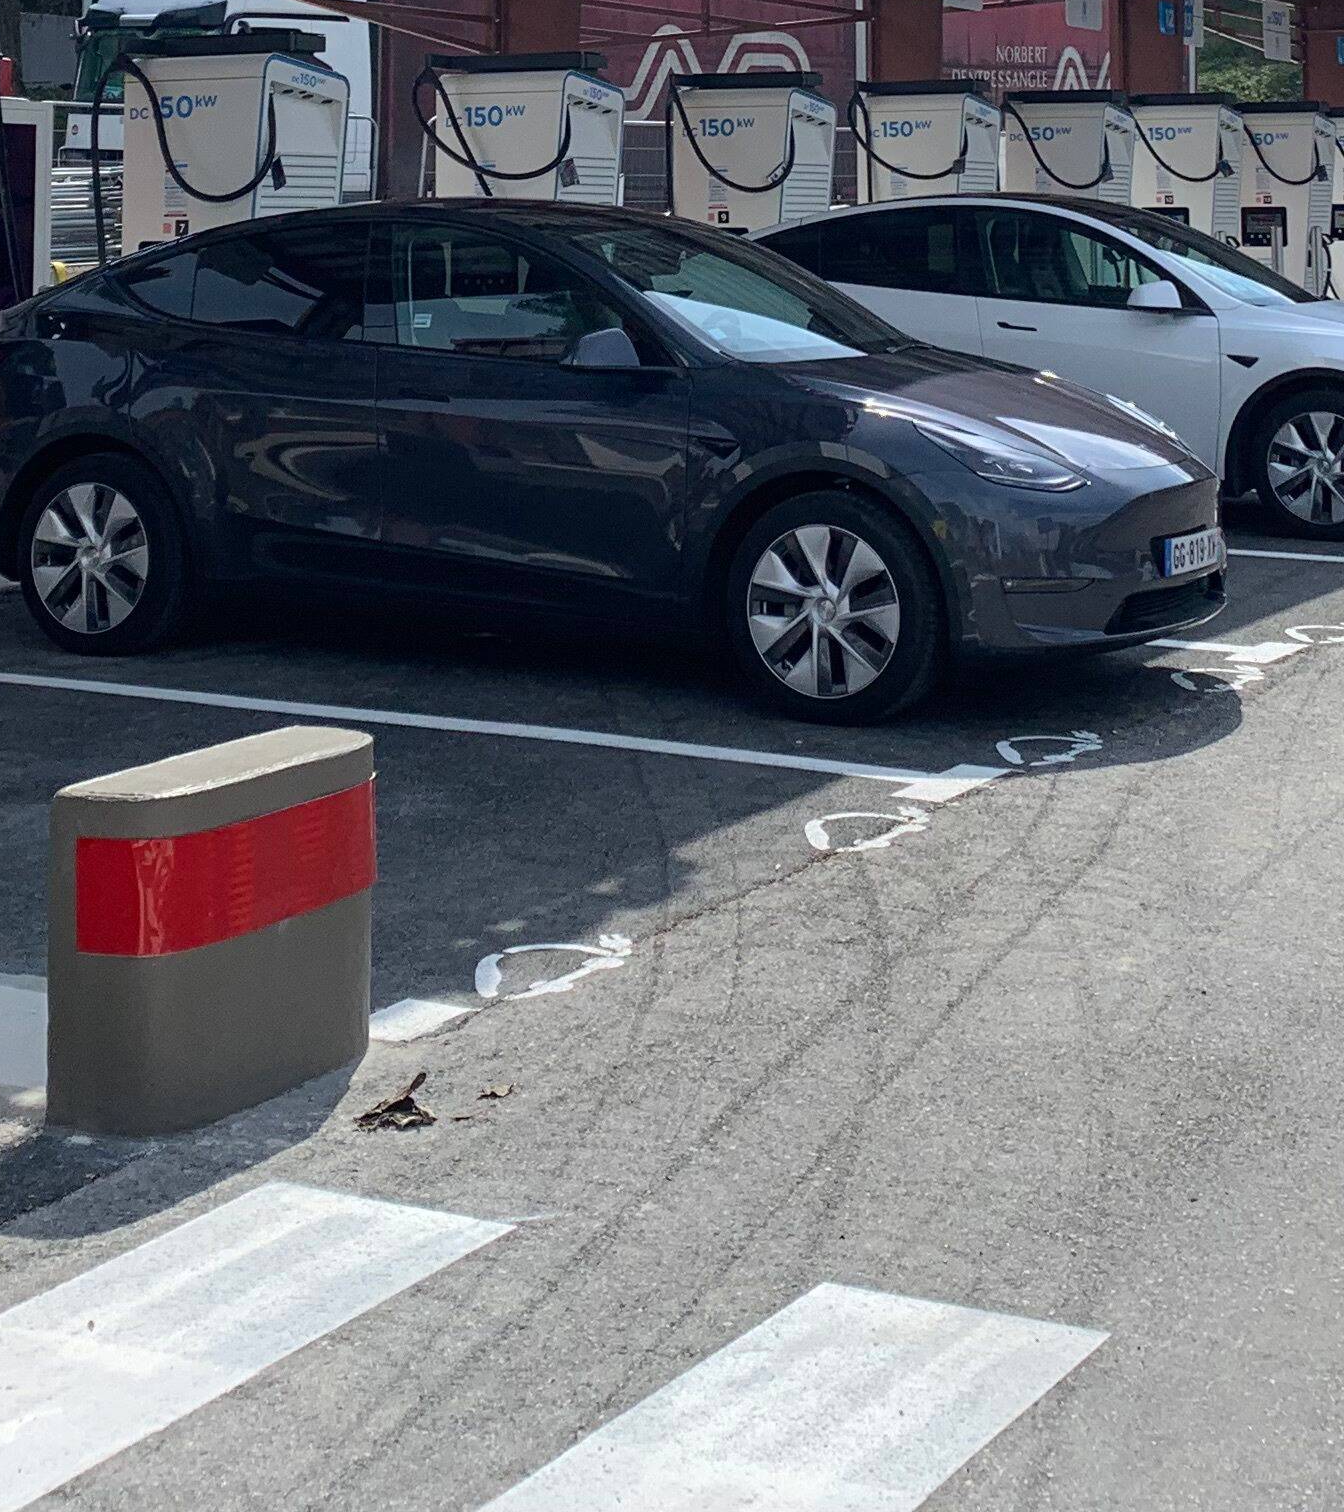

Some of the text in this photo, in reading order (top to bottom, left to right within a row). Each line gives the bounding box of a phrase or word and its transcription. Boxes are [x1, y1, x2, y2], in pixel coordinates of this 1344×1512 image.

[996, 46, 1047, 63] NORBERT
[129, 95, 217, 120] DC 50 kW
[464, 105, 503, 127] 150
[505, 105, 525, 116] kW
[699, 119, 735, 137] 150
[736, 118, 755, 128] kW
[881, 121, 914, 137] 150
[1009, 133, 1024, 141] DC
[1031, 126, 1054, 141] 50
[1148, 127, 1176, 141] 150
[720, 213, 727, 222] 9
[177, 223, 187, 233] 7
